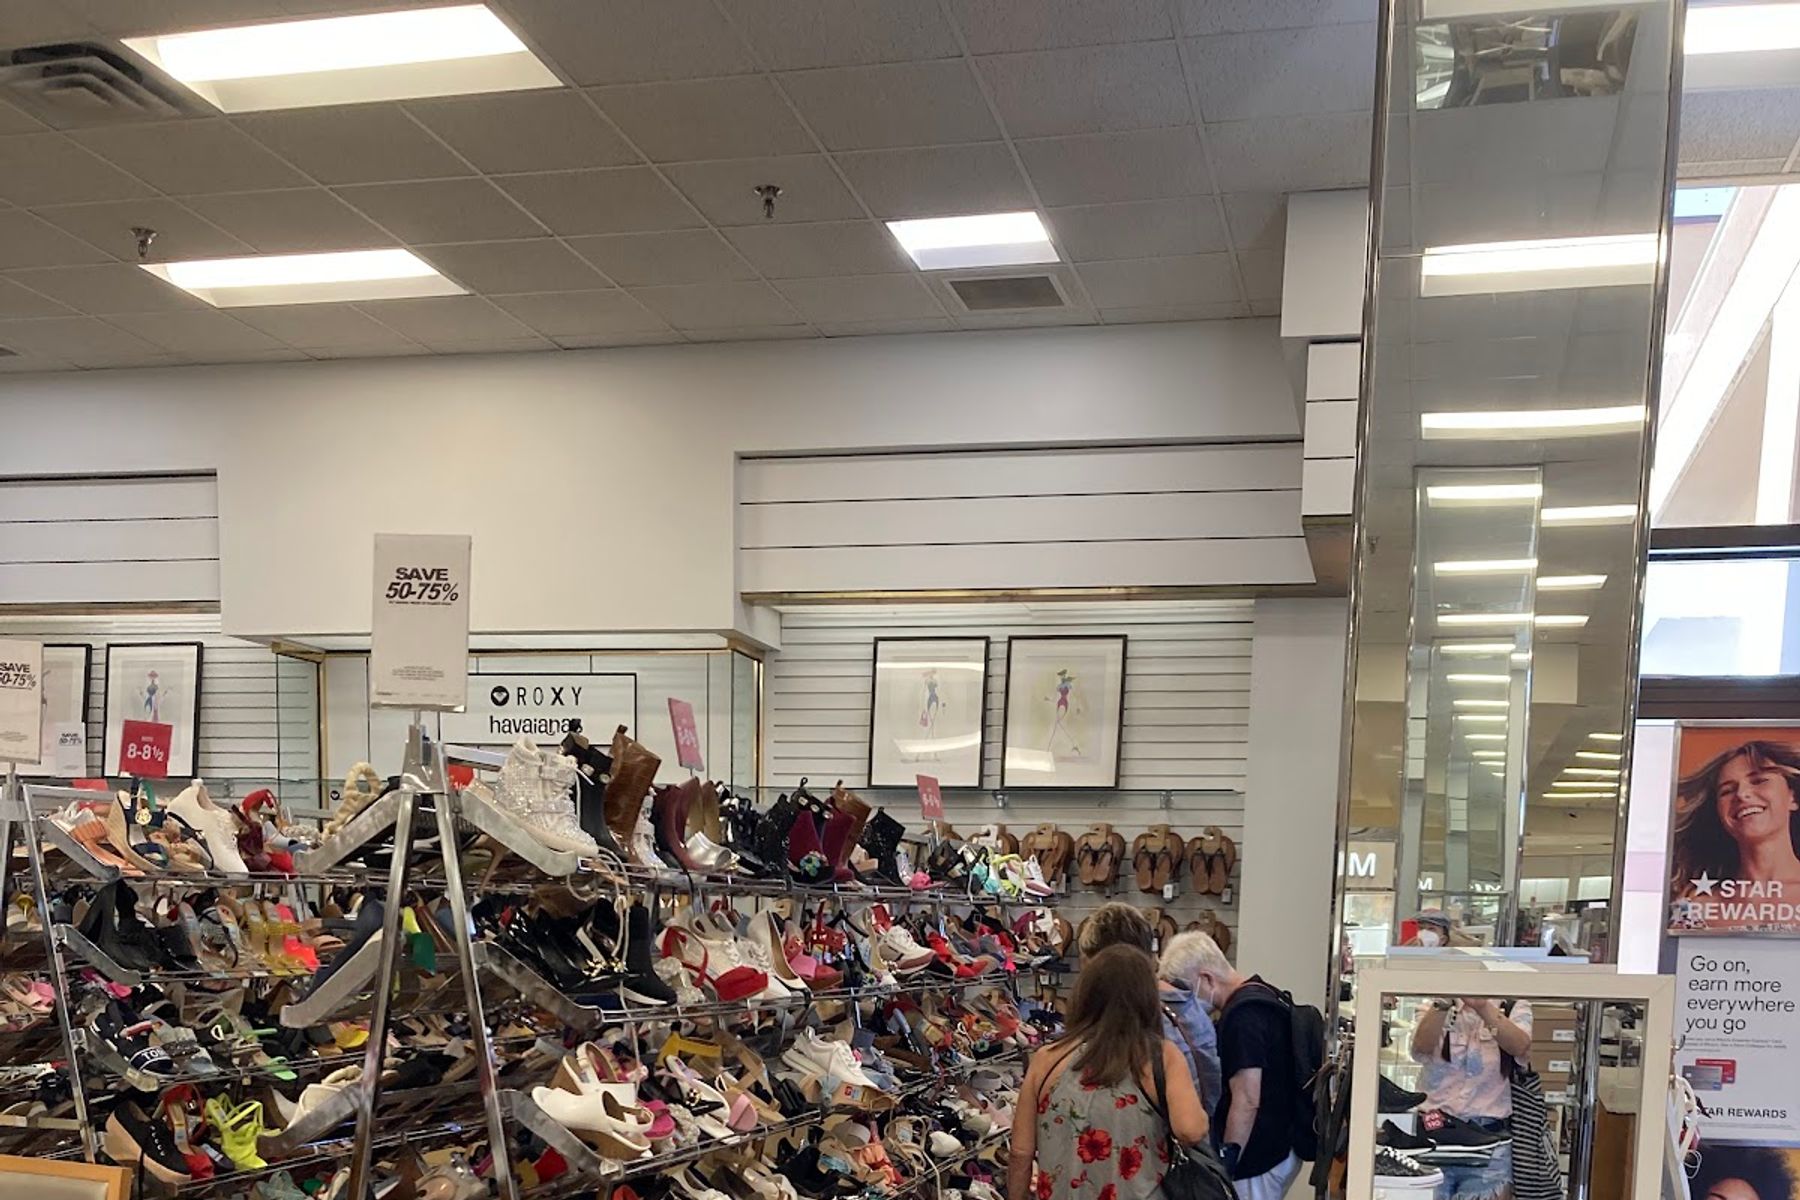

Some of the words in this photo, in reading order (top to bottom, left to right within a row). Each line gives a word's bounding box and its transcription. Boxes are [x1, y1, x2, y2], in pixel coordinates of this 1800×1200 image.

[395, 566, 449, 582] SAVE
[385, 581, 459, 602] 50-75%
[0, 662, 31, 674] SAVE
[516, 686, 583, 706] ROXY
[1720, 879, 1784, 899] STAR
[1690, 954, 1718, 973] Go
[1723, 960, 1751, 975] on,
[1688, 978, 1729, 992] earn
[1734, 979, 1783, 993] more
[1686, 995, 1796, 1016] everywhere
[1684, 1017, 1718, 1034] you
[1722, 1018, 1747, 1035] go
[1697, 1106, 1724, 1117] TAR
[1727, 1107, 1788, 1119] REWARDS
